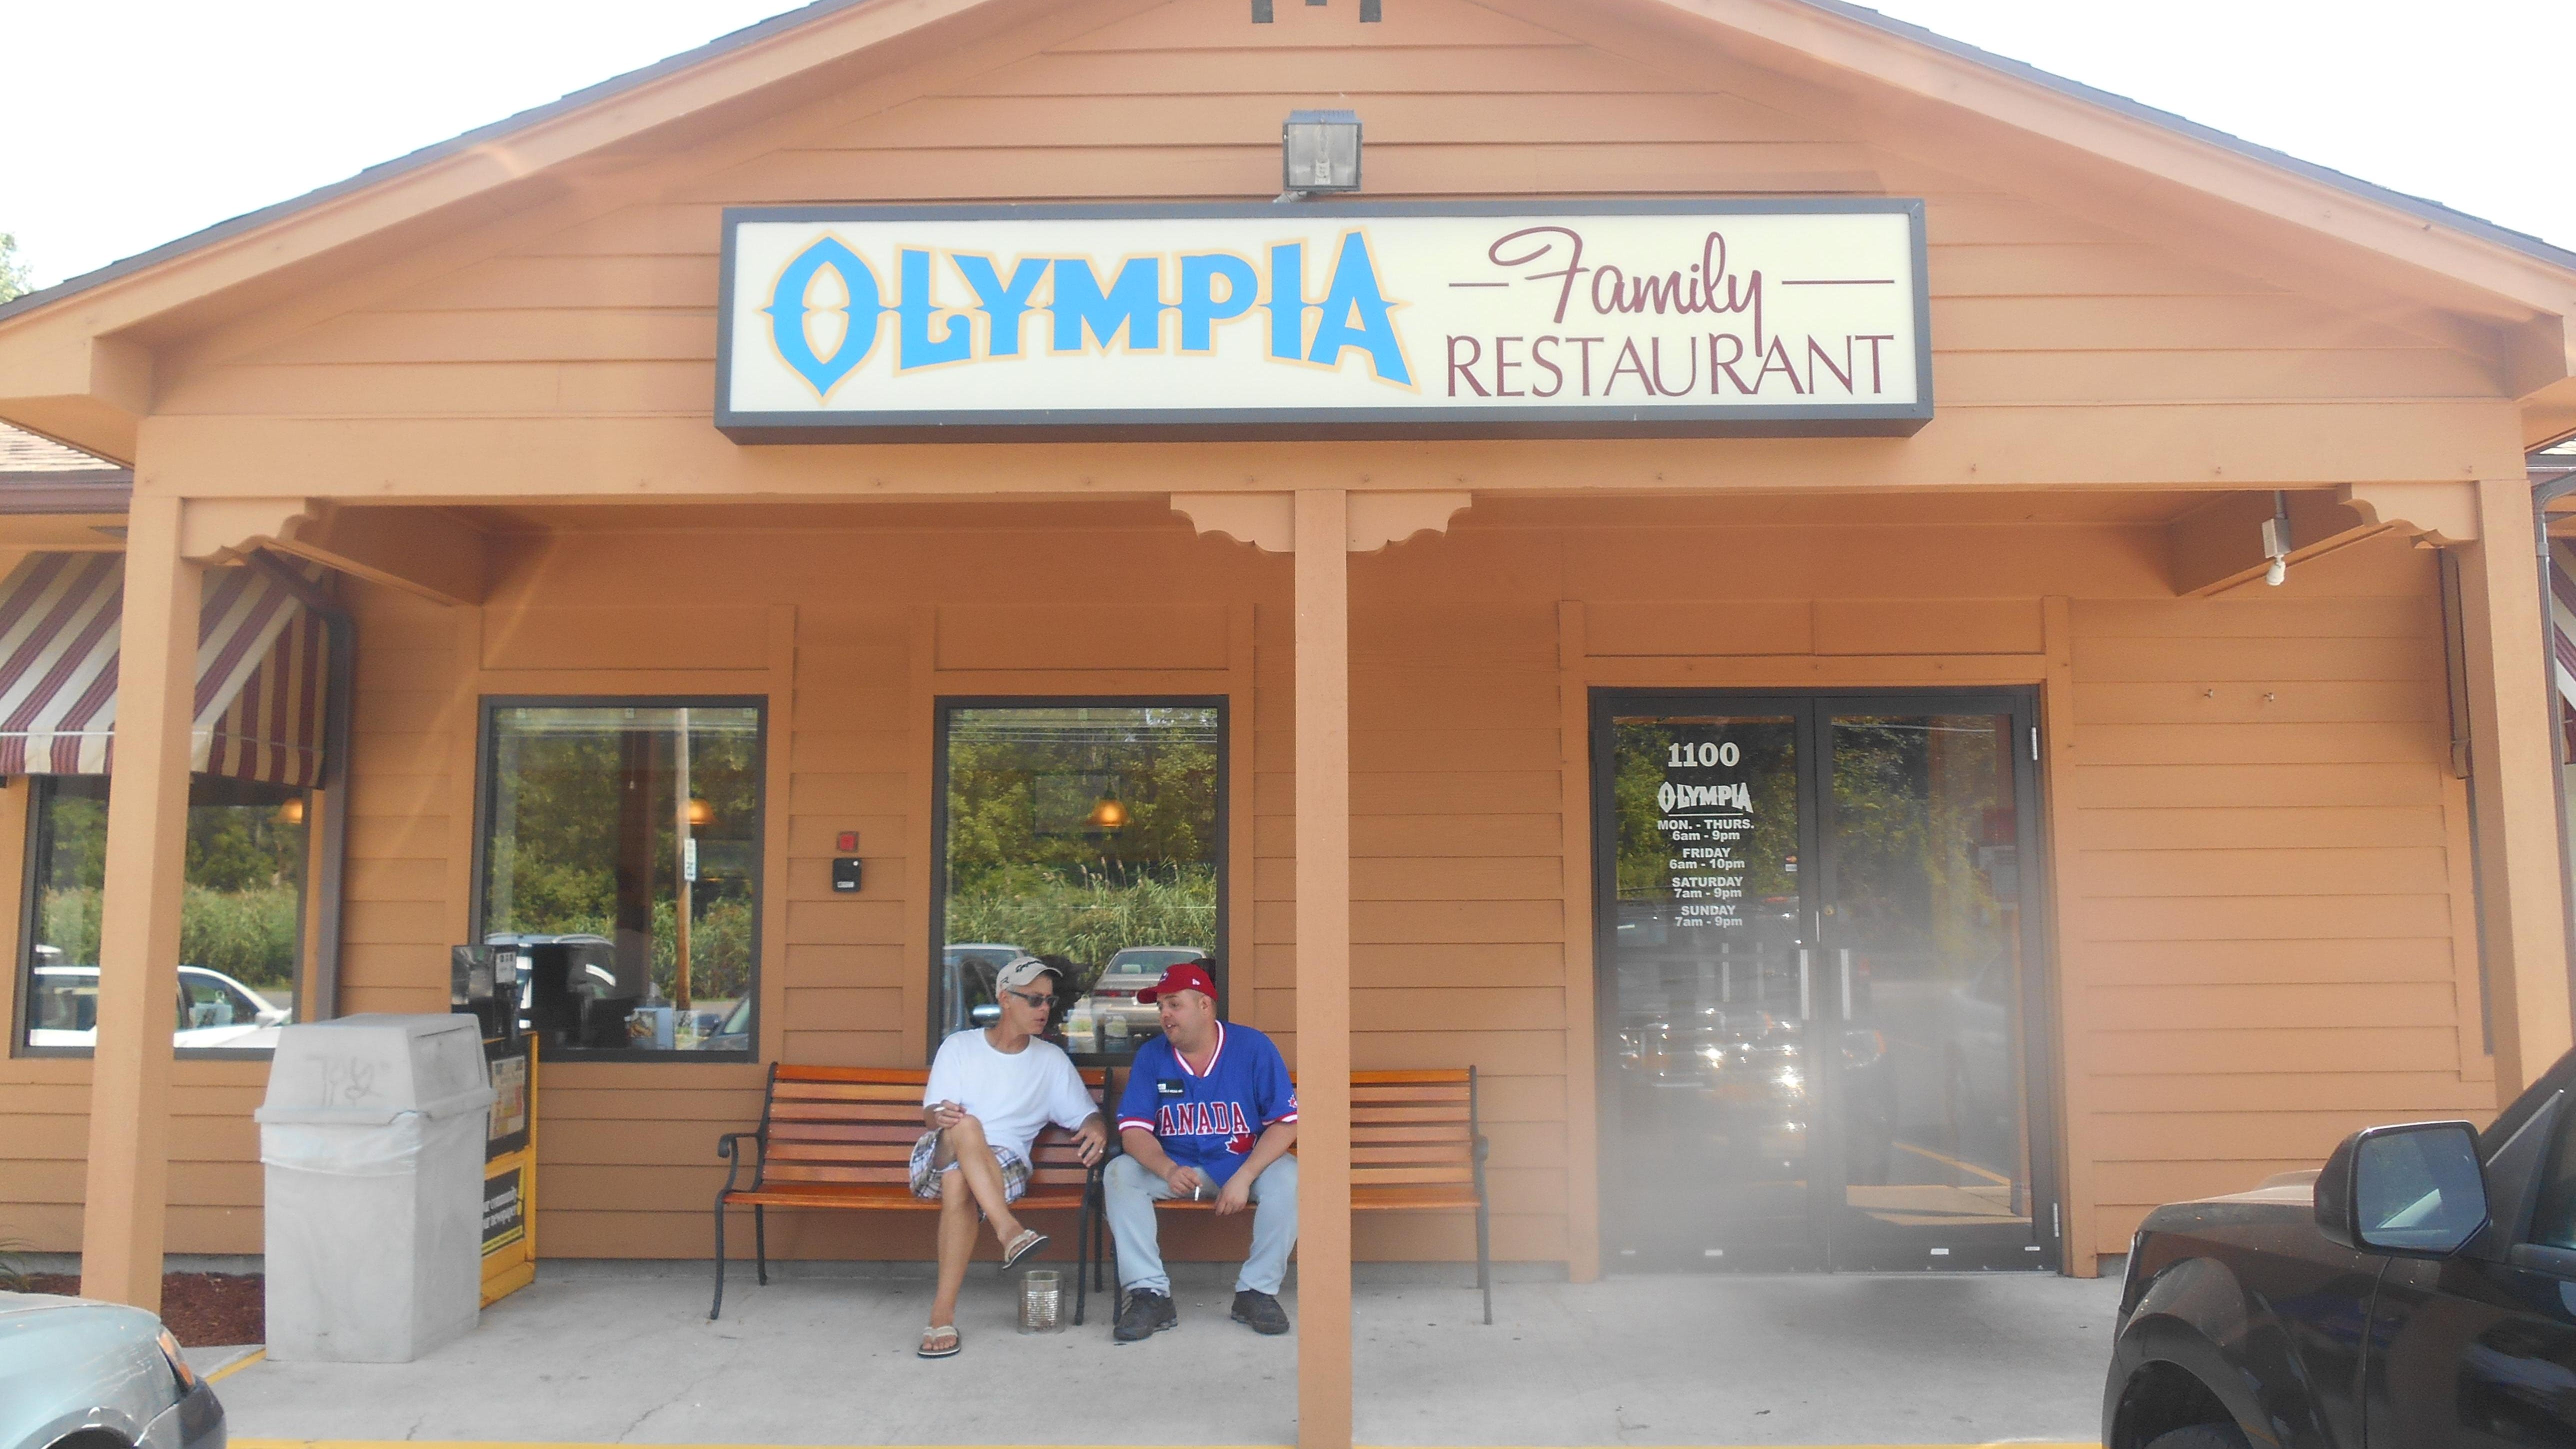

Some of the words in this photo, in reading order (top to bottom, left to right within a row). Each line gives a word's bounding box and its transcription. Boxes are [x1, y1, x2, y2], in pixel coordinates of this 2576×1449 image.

[1488, 226, 1762, 358] Family
[752, 226, 1420, 406] OLYMPIA
[1446, 332, 1894, 397] RESTAURANT
[1668, 742, 1740, 767] 1100
[1657, 782, 1754, 814] OLYMPIA
[1658, 820, 1692, 830] MON.
[1704, 819, 1754, 830] THURS.
[1672, 830, 1700, 840] 6am
[1712, 830, 1740, 842] 9pm
[1682, 848, 1731, 858] FRIDAY
[1670, 859, 1698, 869] 6am
[1710, 858, 1745, 870] 10pm
[1672, 876, 1744, 887] SATURDAY
[1674, 888, 1702, 898] 7am
[1714, 888, 1742, 900] 9pm
[1681, 906, 1736, 916] SUNDAY
[1675, 916, 1703, 926] 7am
[1714, 916, 1742, 928] 9pm
